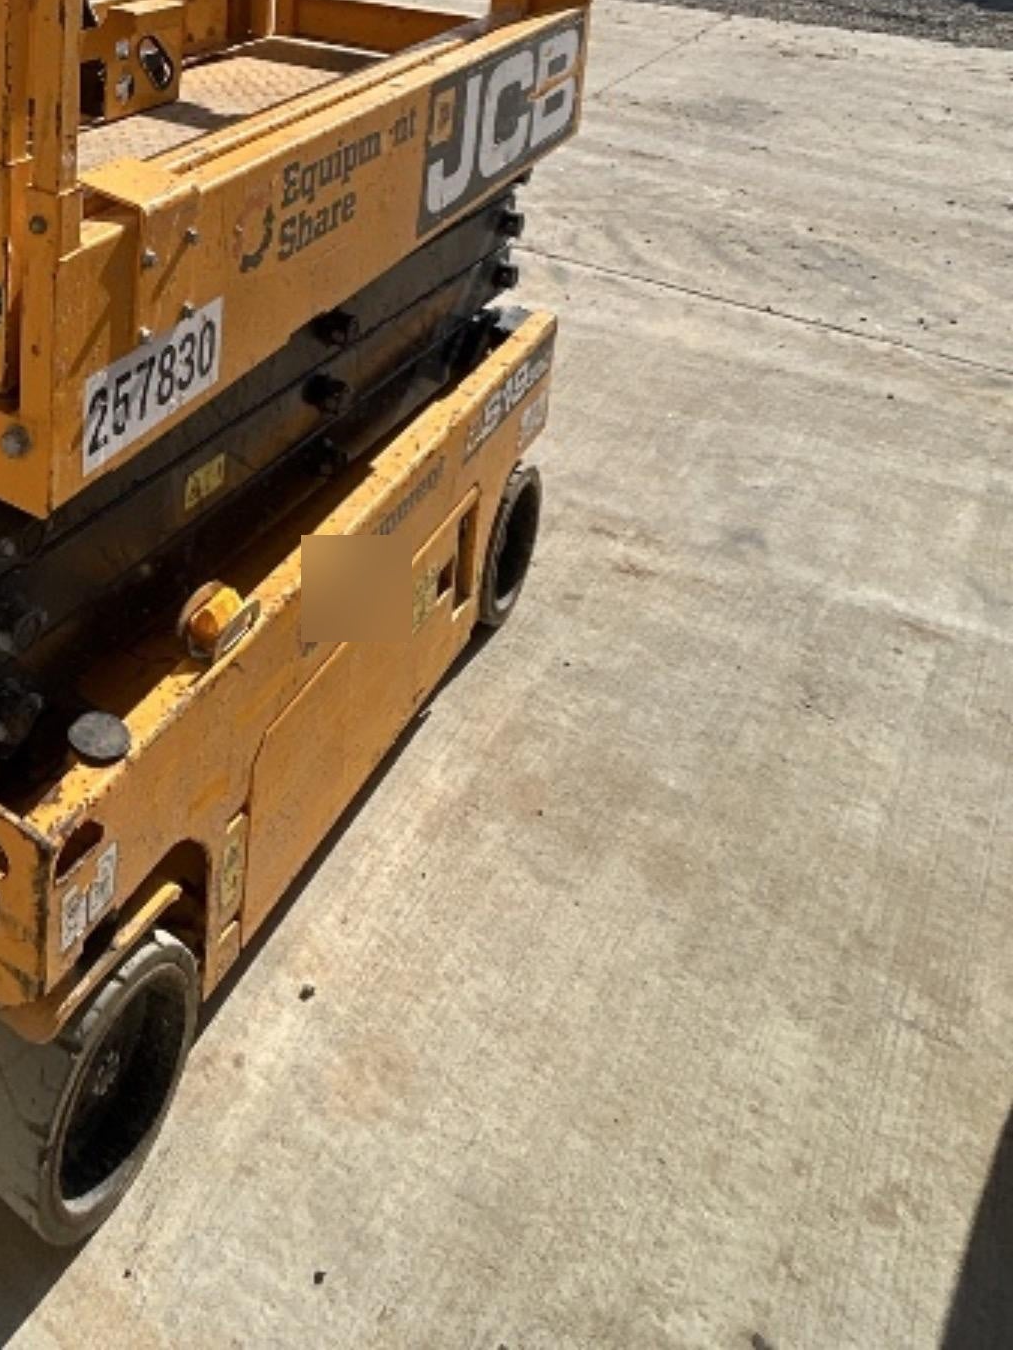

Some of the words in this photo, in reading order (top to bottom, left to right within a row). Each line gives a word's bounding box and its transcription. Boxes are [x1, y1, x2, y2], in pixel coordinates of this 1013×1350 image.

[281, 106, 419, 212] Equipmnt
[425, 28, 584, 216] JCB
[276, 190, 358, 263] Share
[87, 318, 217, 458] 257830
